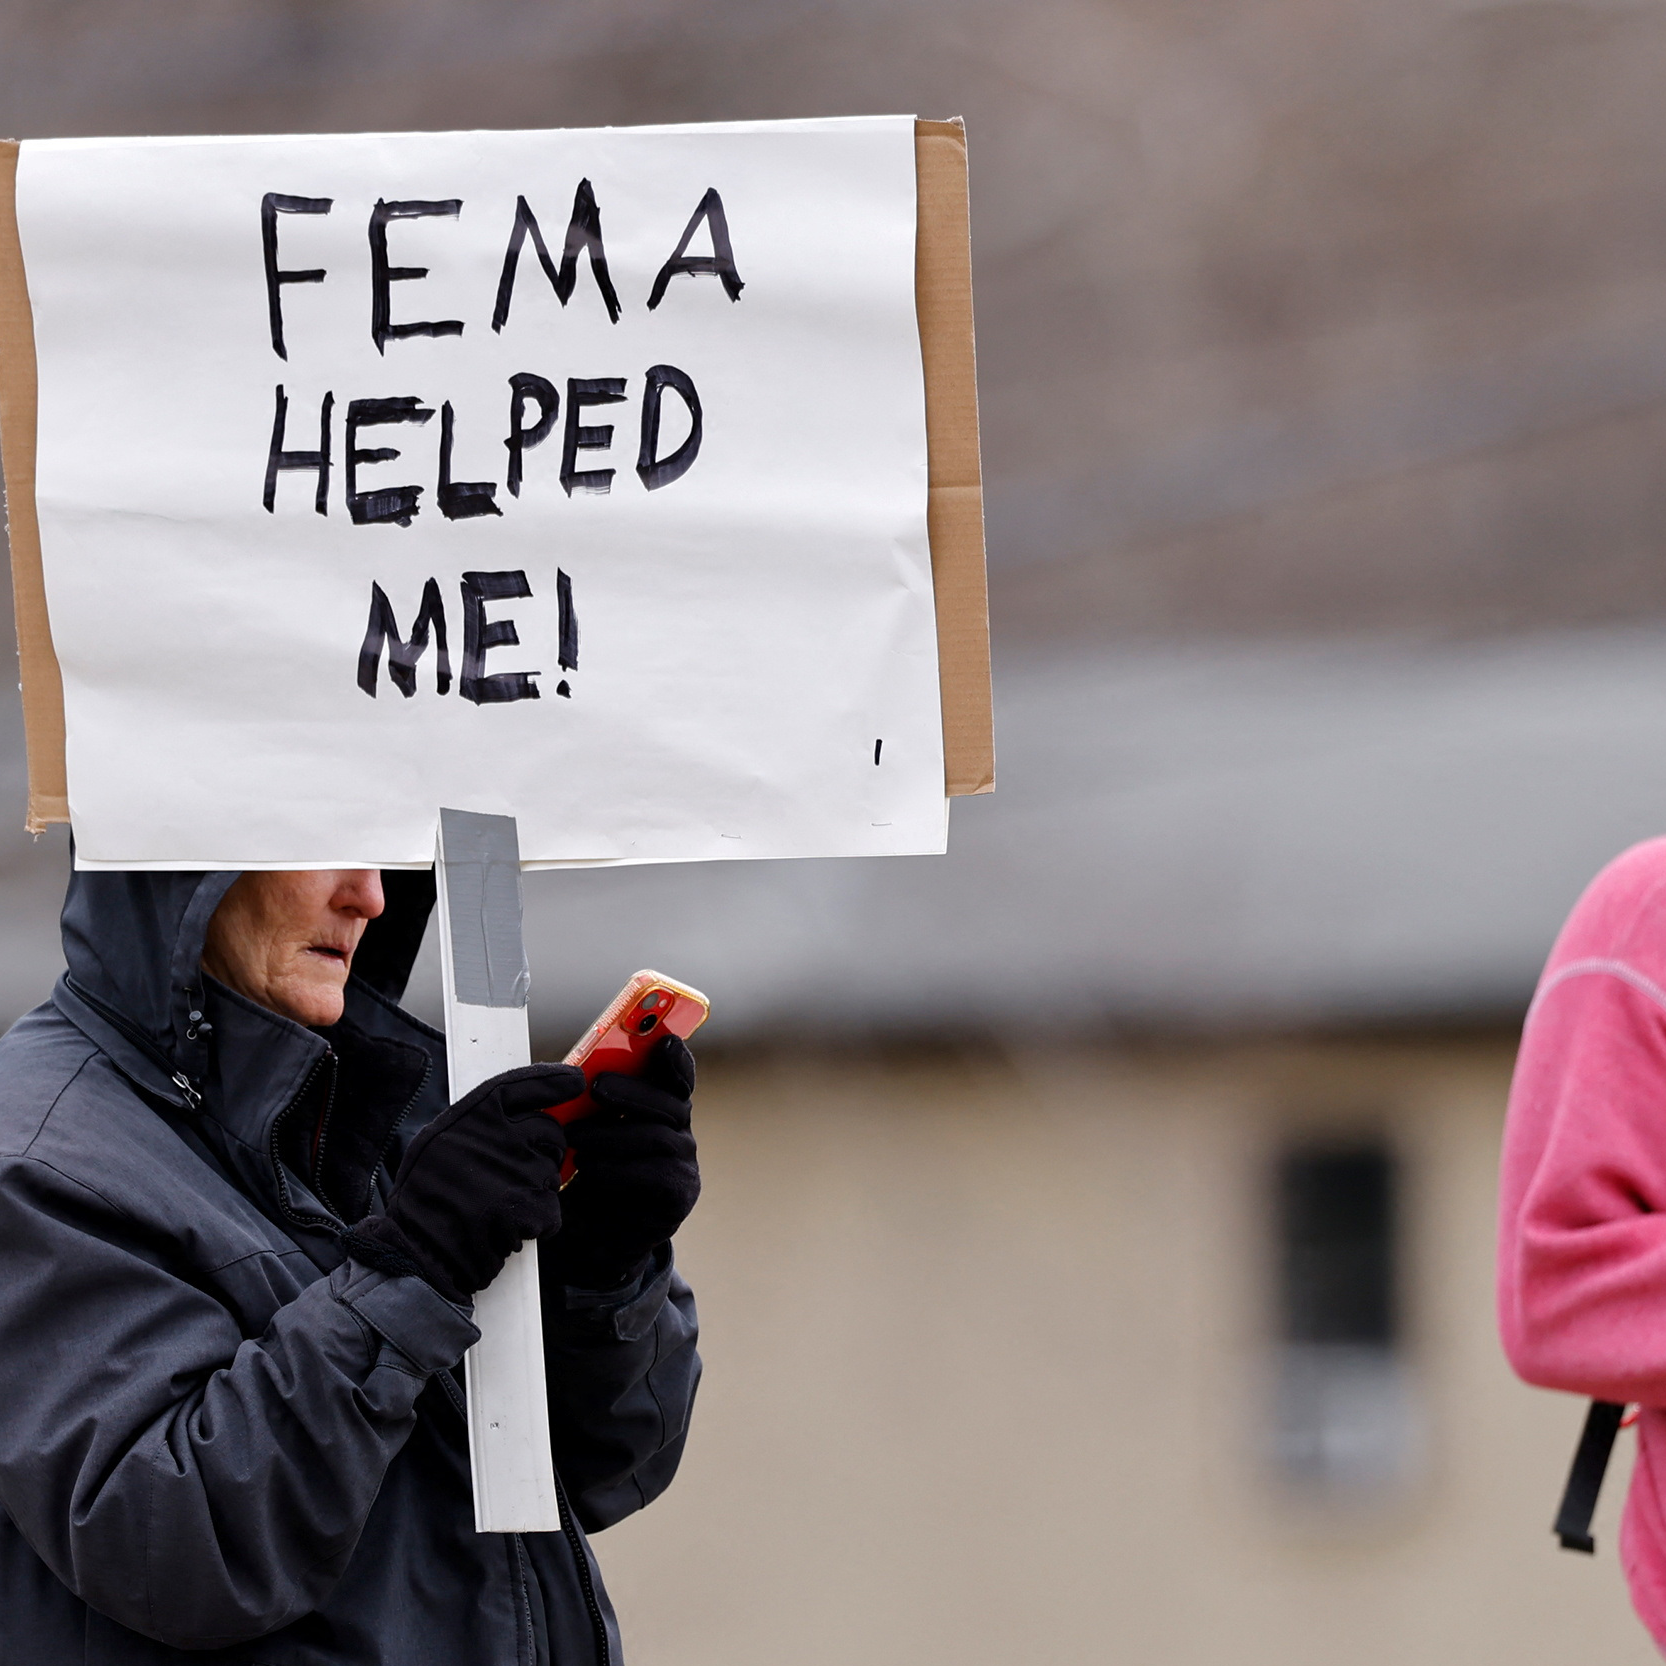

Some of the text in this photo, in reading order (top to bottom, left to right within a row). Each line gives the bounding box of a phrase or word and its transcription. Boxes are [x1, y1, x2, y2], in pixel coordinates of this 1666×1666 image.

[260, 177, 746, 362] FEMA
[262, 364, 704, 528] HELPED
[355, 566, 579, 707] ME!
